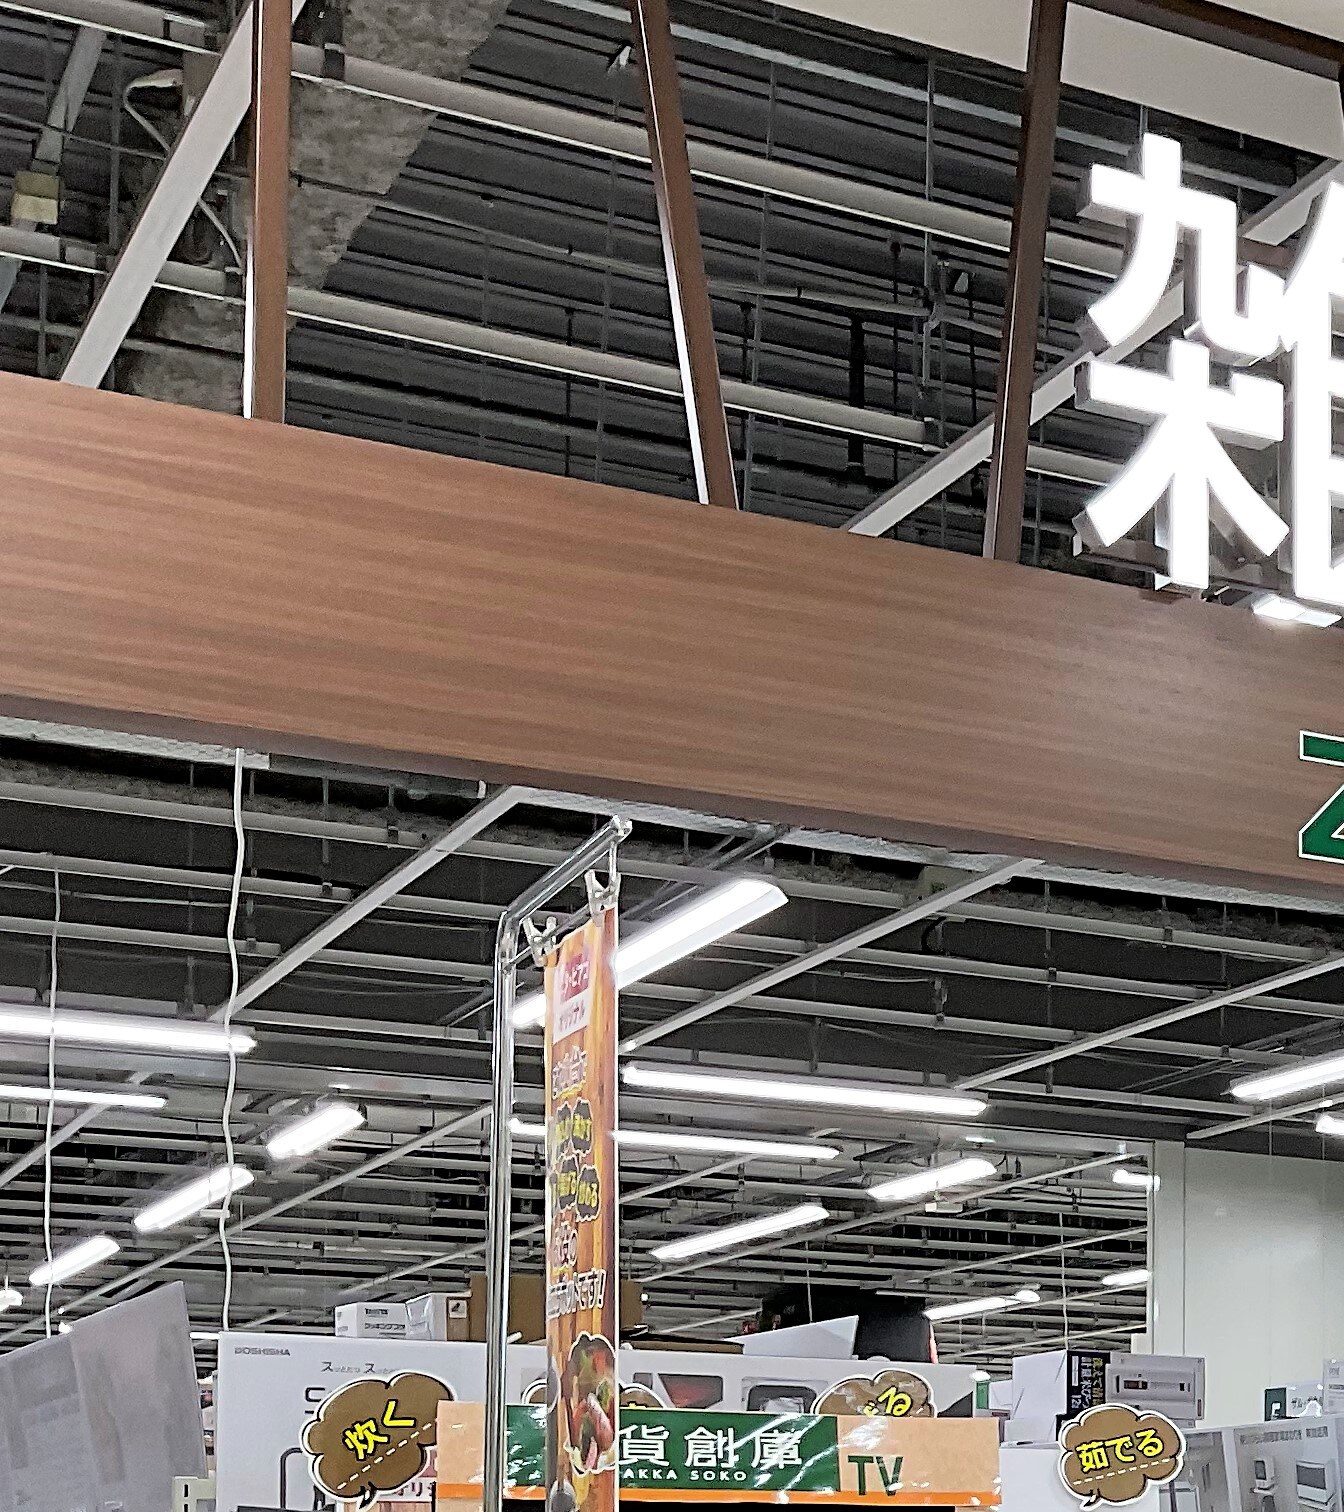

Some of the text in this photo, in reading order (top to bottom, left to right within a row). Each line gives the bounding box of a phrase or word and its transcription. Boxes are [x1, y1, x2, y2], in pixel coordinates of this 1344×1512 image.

[342, 1400, 415, 1461] 炊く
[617, 1421, 803, 1473] 貨創庫
[1075, 1429, 1165, 1472] 茹でる
[847, 1455, 903, 1497] TV
